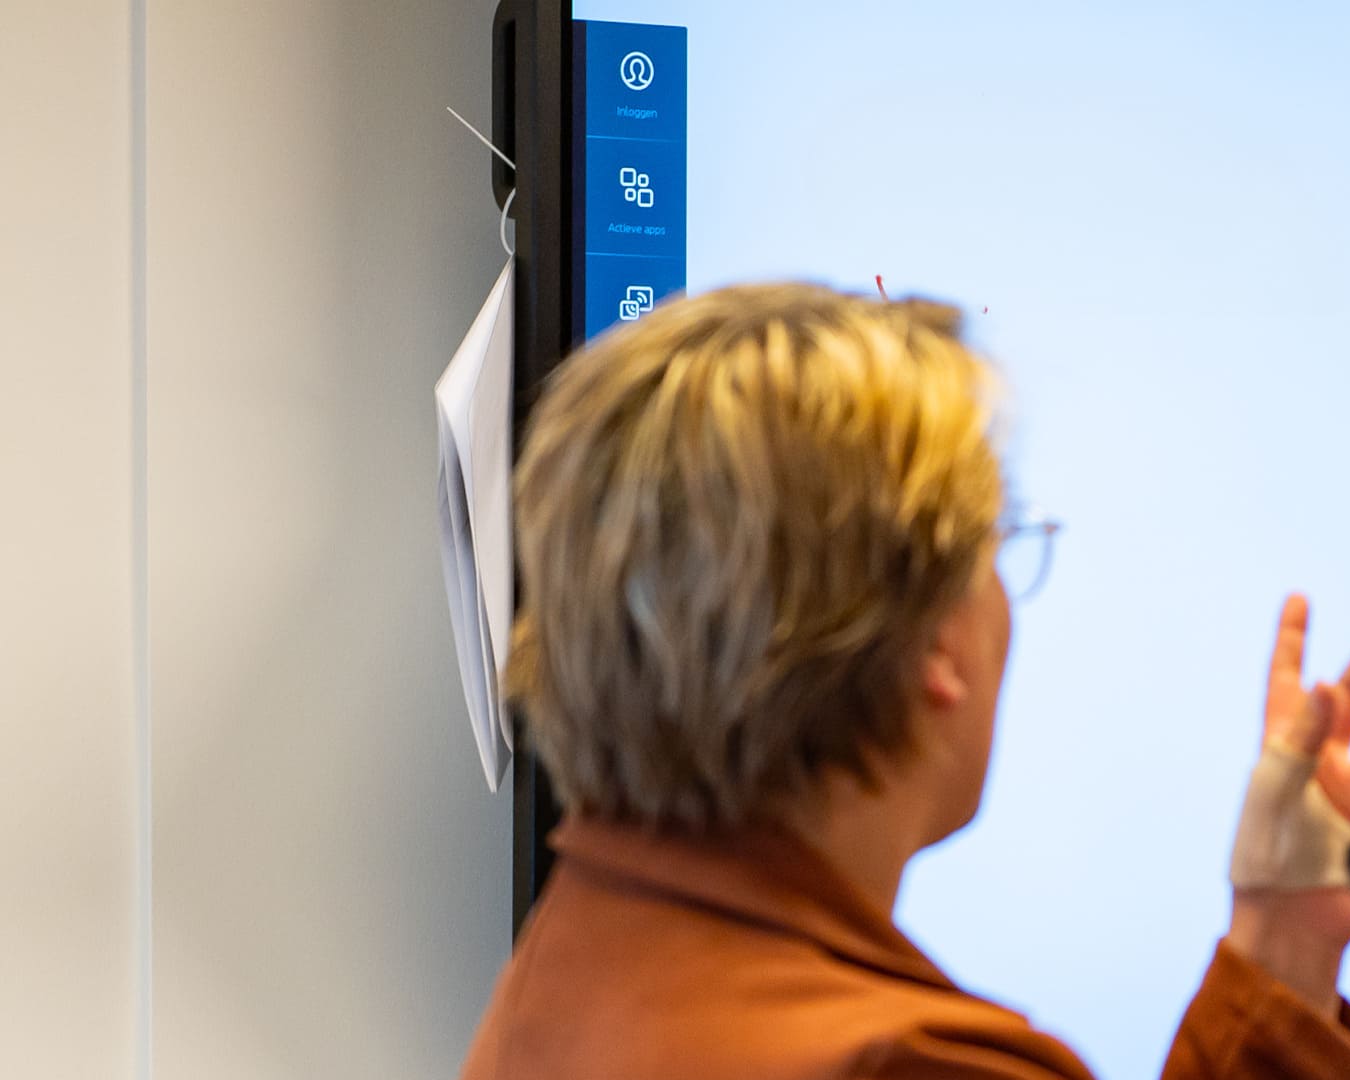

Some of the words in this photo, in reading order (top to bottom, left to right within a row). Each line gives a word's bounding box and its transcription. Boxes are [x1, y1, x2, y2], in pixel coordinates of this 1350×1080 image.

[617, 105, 658, 119] Inloggen
[607, 222, 642, 234] Actieve
[643, 226, 666, 237] apps
